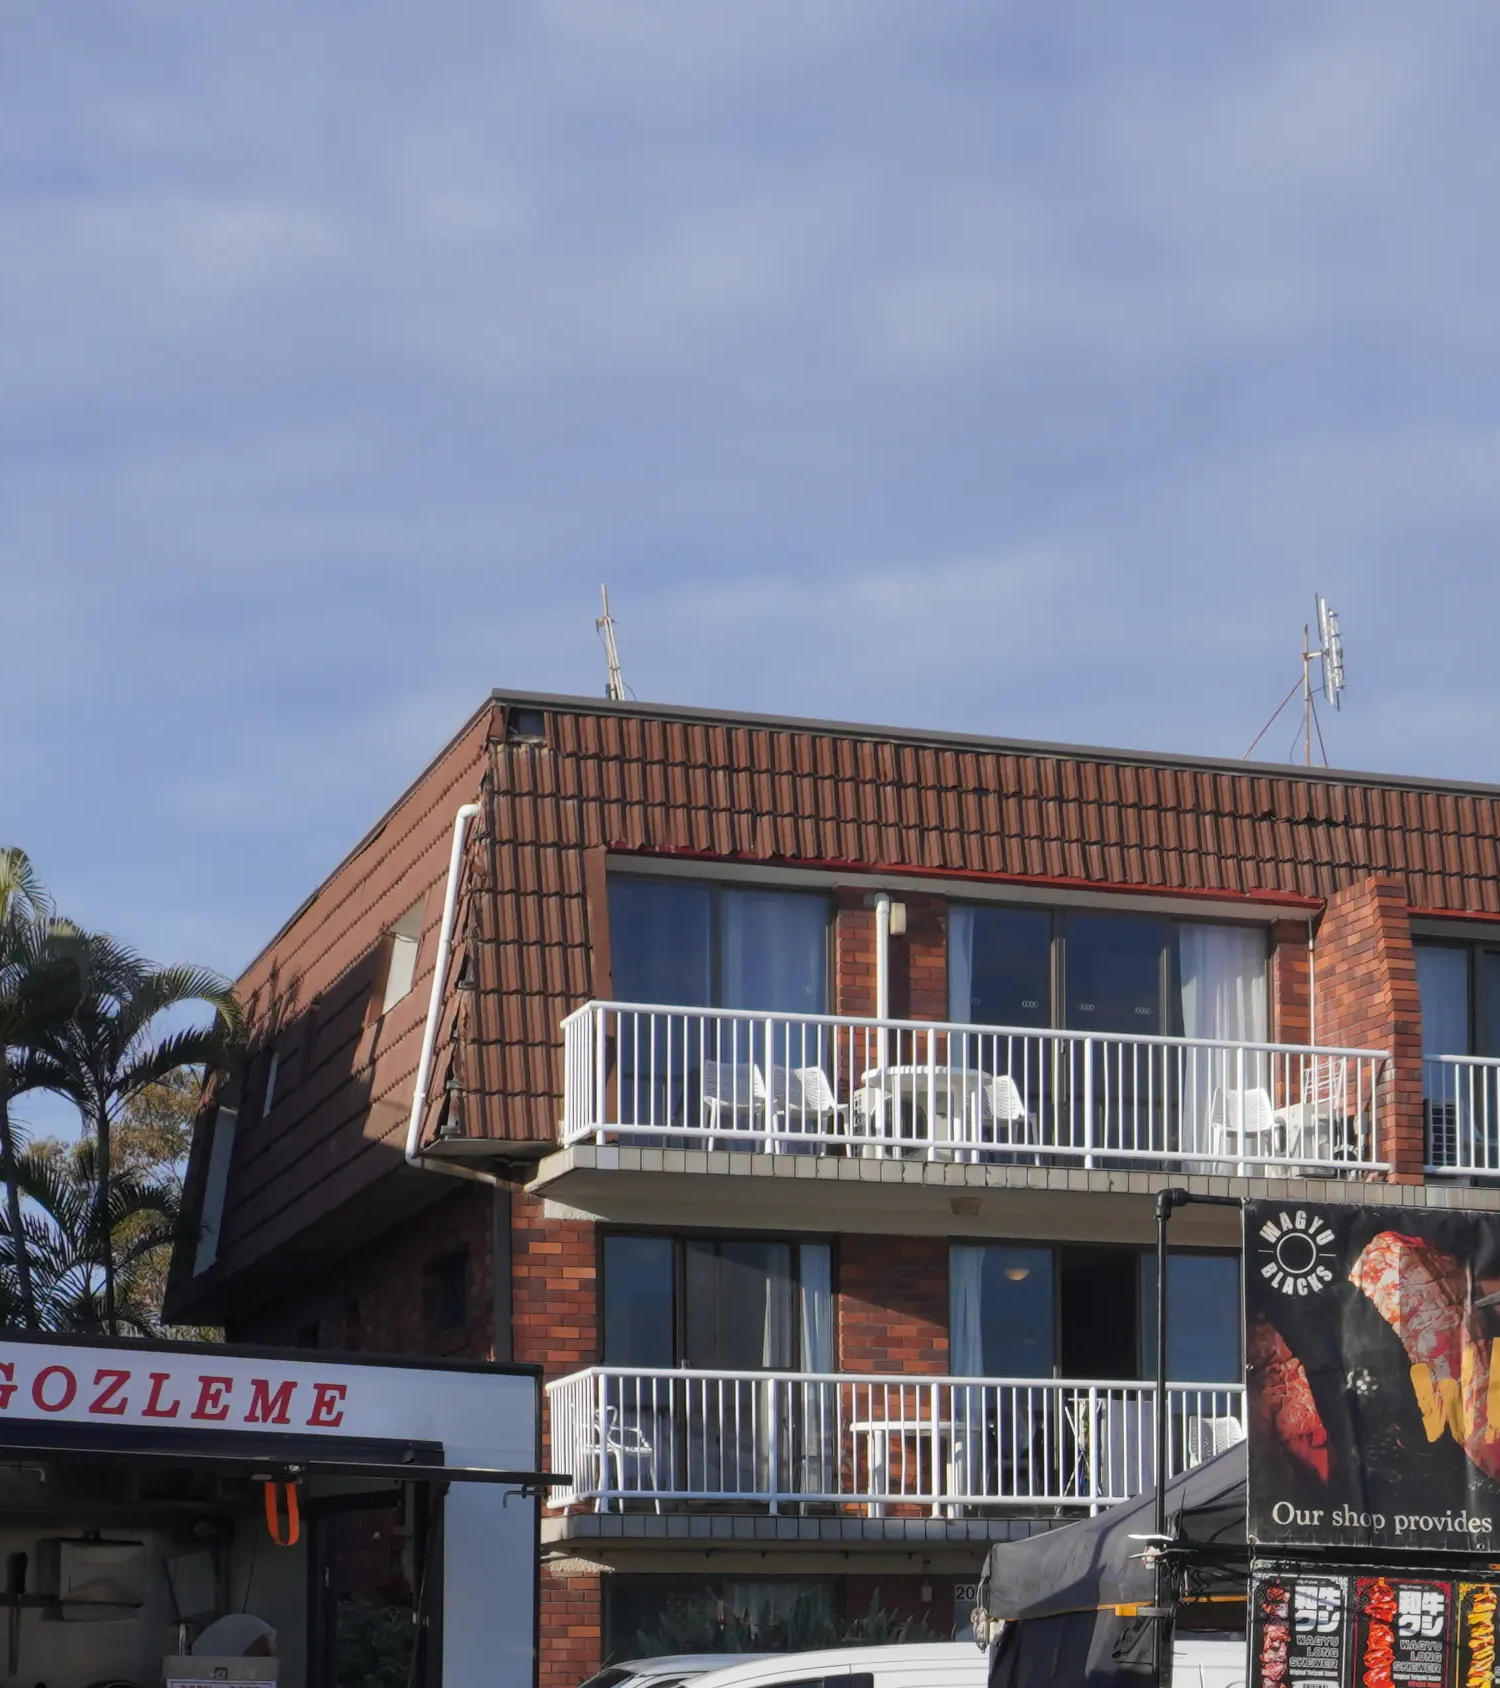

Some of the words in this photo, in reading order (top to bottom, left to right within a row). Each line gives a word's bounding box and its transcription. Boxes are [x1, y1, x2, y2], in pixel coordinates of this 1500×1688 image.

[1259, 1210, 1335, 1246] WAGYU
[1261, 1261, 1333, 1296] BLACKS
[1272, 1501, 1323, 1526] Our
[1332, 1504, 1386, 1532] shop
[1395, 1510, 1493, 1534] provides
[956, 1586, 975, 1600] 20
[1296, 1635, 1339, 1646] WAGYU
[1400, 1640, 1442, 1651] WAGYU
[1306, 1647, 1338, 1657] LONG
[1410, 1651, 1442, 1662] LONG
[1289, 1658, 1338, 1669] SKEWER
[1393, 1661, 1441, 1673] SKEWER
